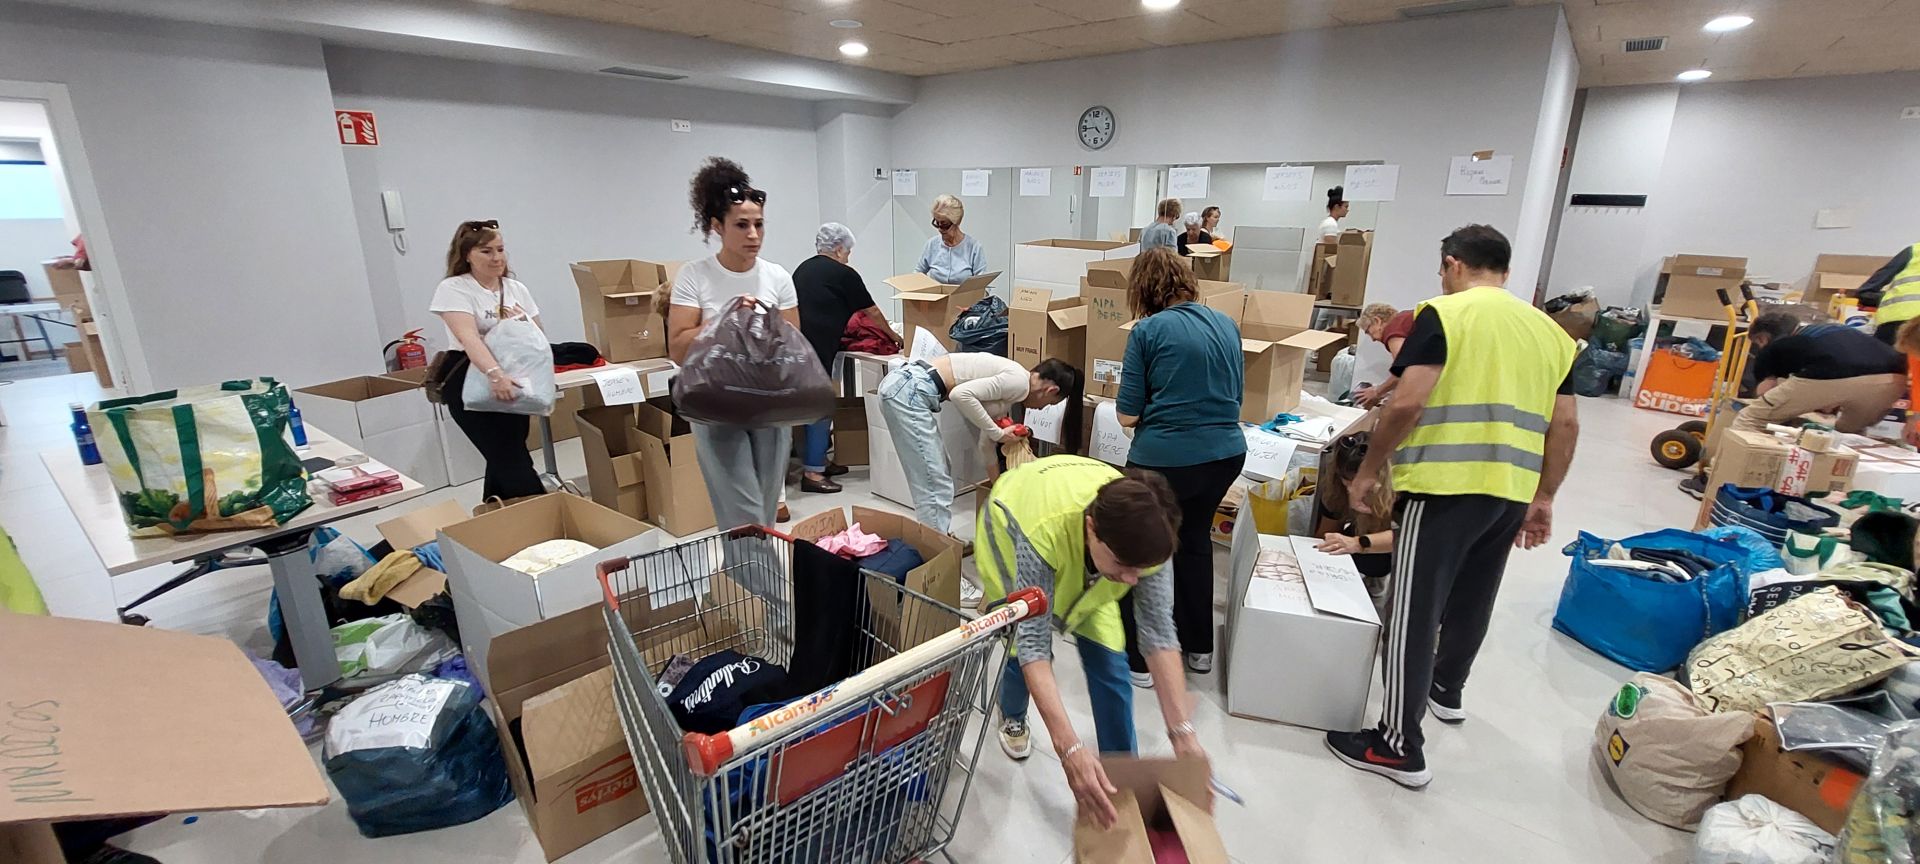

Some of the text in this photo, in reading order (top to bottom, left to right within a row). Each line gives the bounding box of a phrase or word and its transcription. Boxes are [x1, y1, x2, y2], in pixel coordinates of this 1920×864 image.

[1092, 110, 1100, 119] 12
[1104, 122, 1110, 130] 3
[368, 711, 430, 729] HOMBRE
